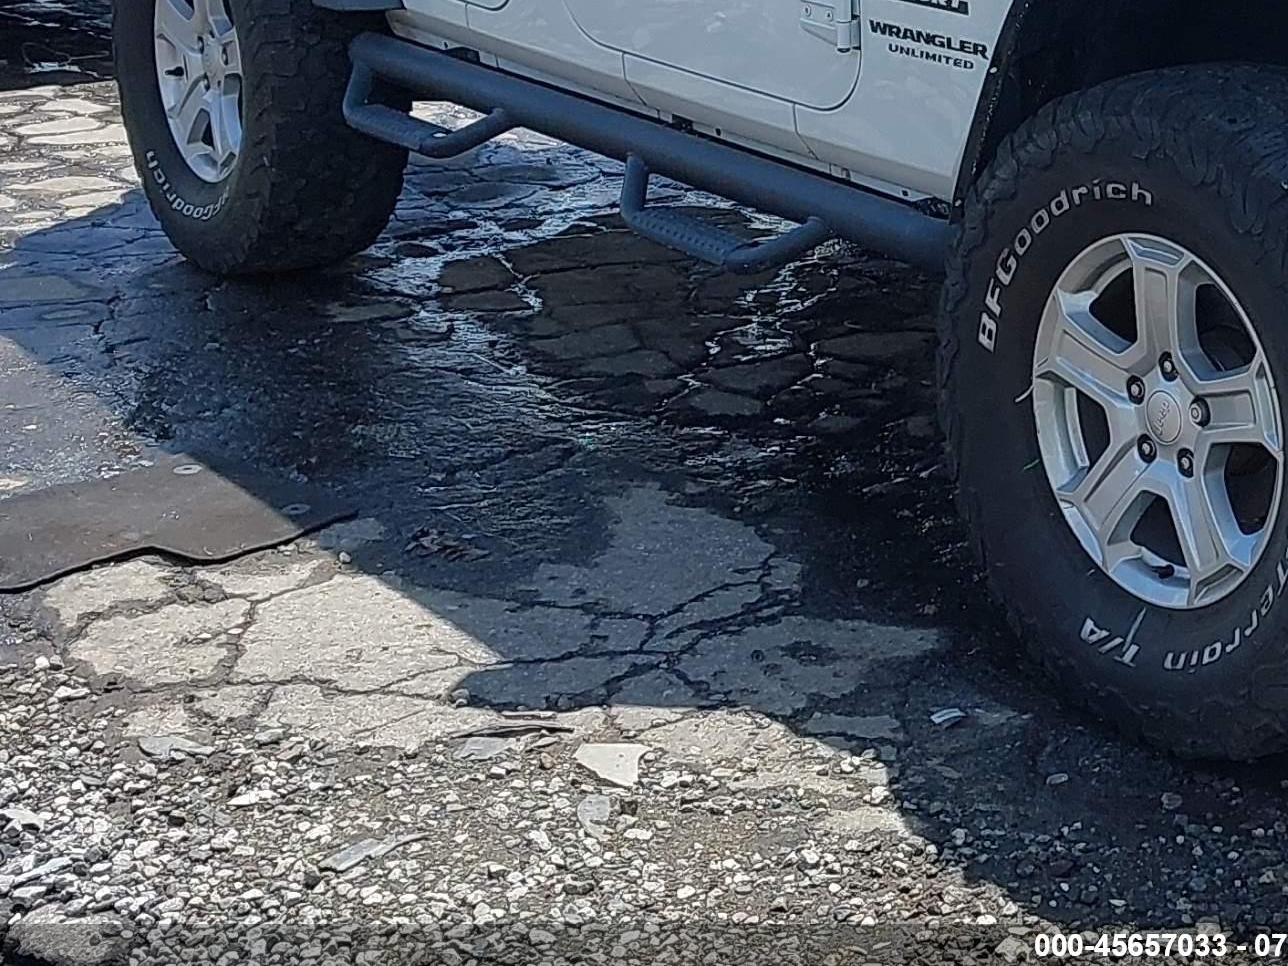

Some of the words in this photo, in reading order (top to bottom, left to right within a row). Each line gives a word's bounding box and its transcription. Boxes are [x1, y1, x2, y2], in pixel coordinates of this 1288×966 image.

[868, 18, 989, 60] WRANGLER
[887, 42, 974, 70] UNLIMITED
[977, 178, 1153, 354] BFGoodrich
[1080, 617, 1142, 667] T/A
